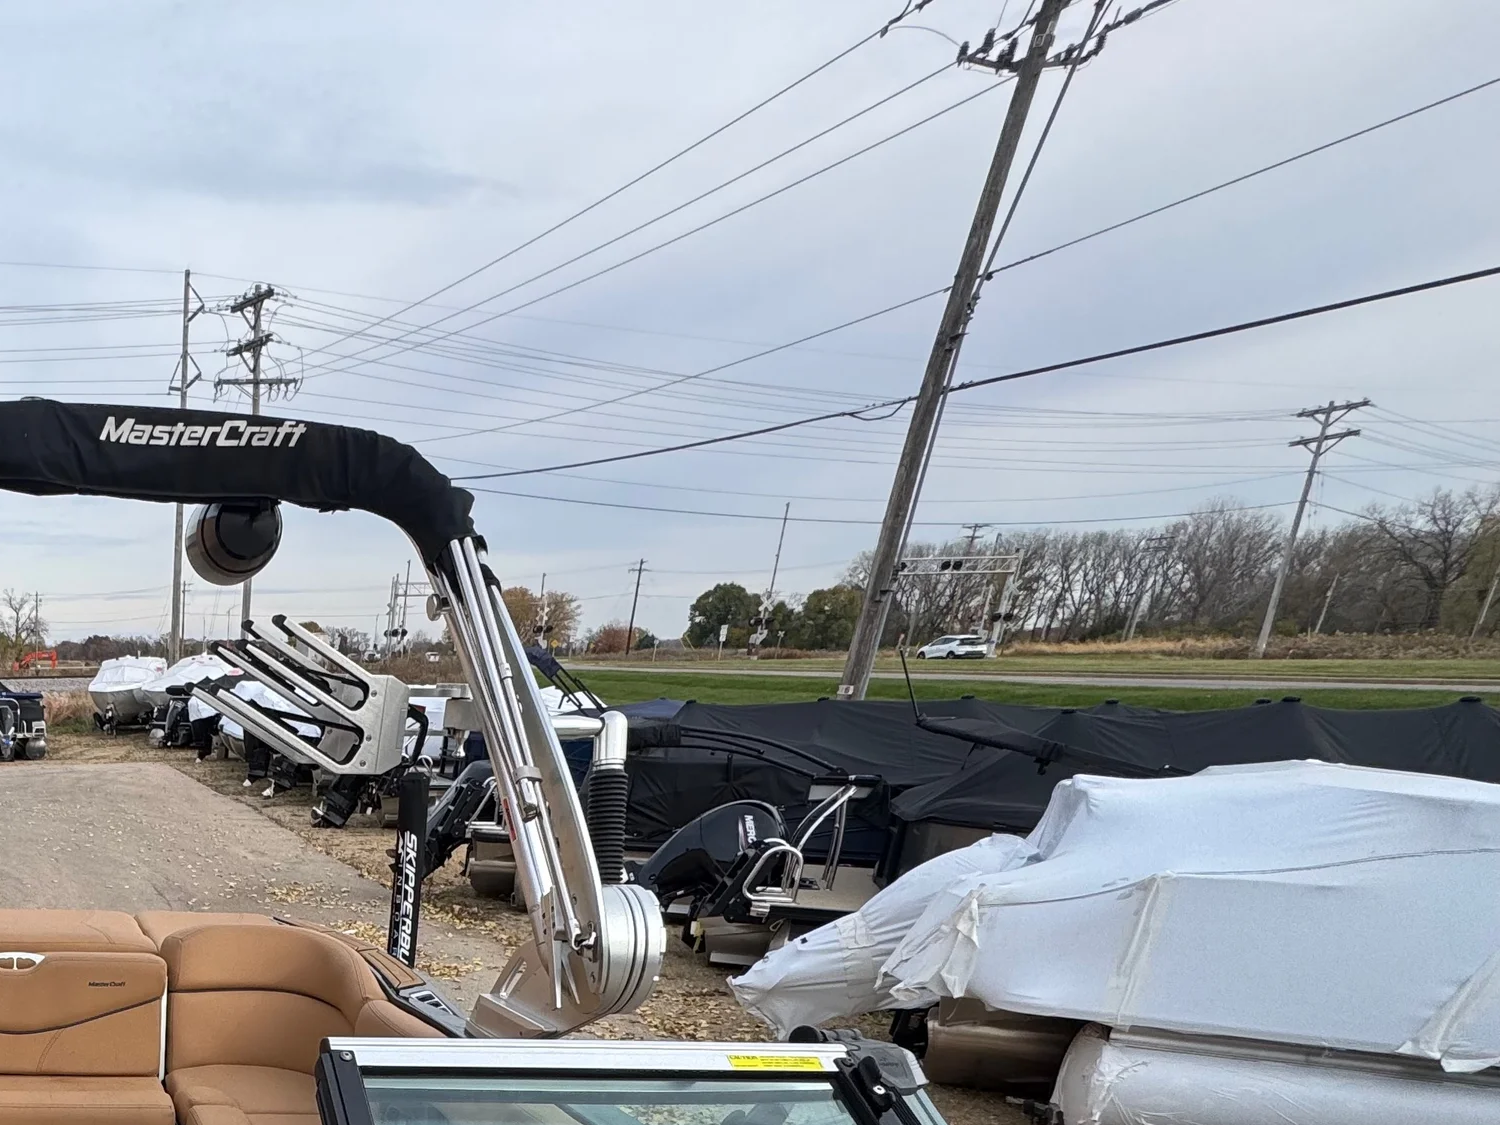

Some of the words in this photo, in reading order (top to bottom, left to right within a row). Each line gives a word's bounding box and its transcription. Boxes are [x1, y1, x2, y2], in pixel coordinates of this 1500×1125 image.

[99, 416, 307, 448] MasterCraft
[744, 814, 757, 843] MERC
[399, 833, 418, 965] SKIPPERBU
